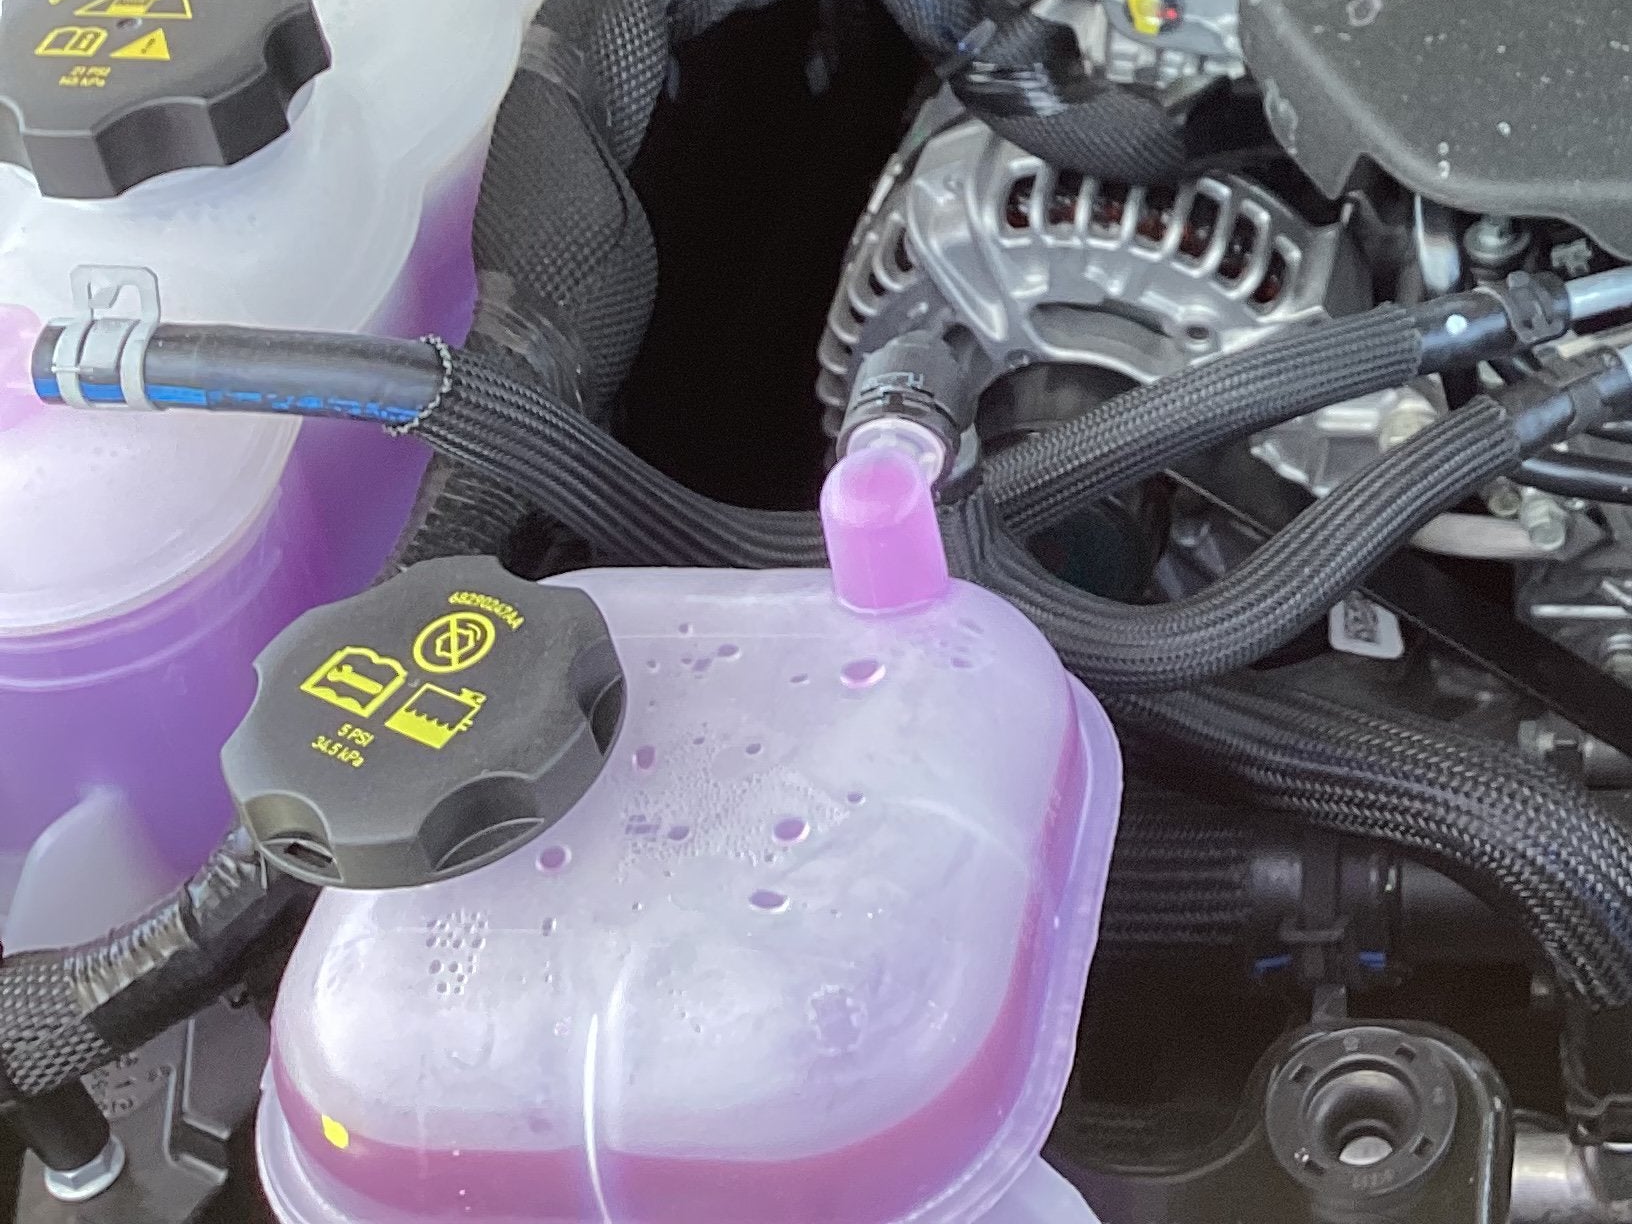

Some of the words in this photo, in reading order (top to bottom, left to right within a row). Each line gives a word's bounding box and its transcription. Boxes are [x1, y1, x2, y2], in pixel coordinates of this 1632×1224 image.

[337, 722, 353, 737] 5
[346, 727, 376, 748] PSI
[337, 746, 365, 768] kPa
